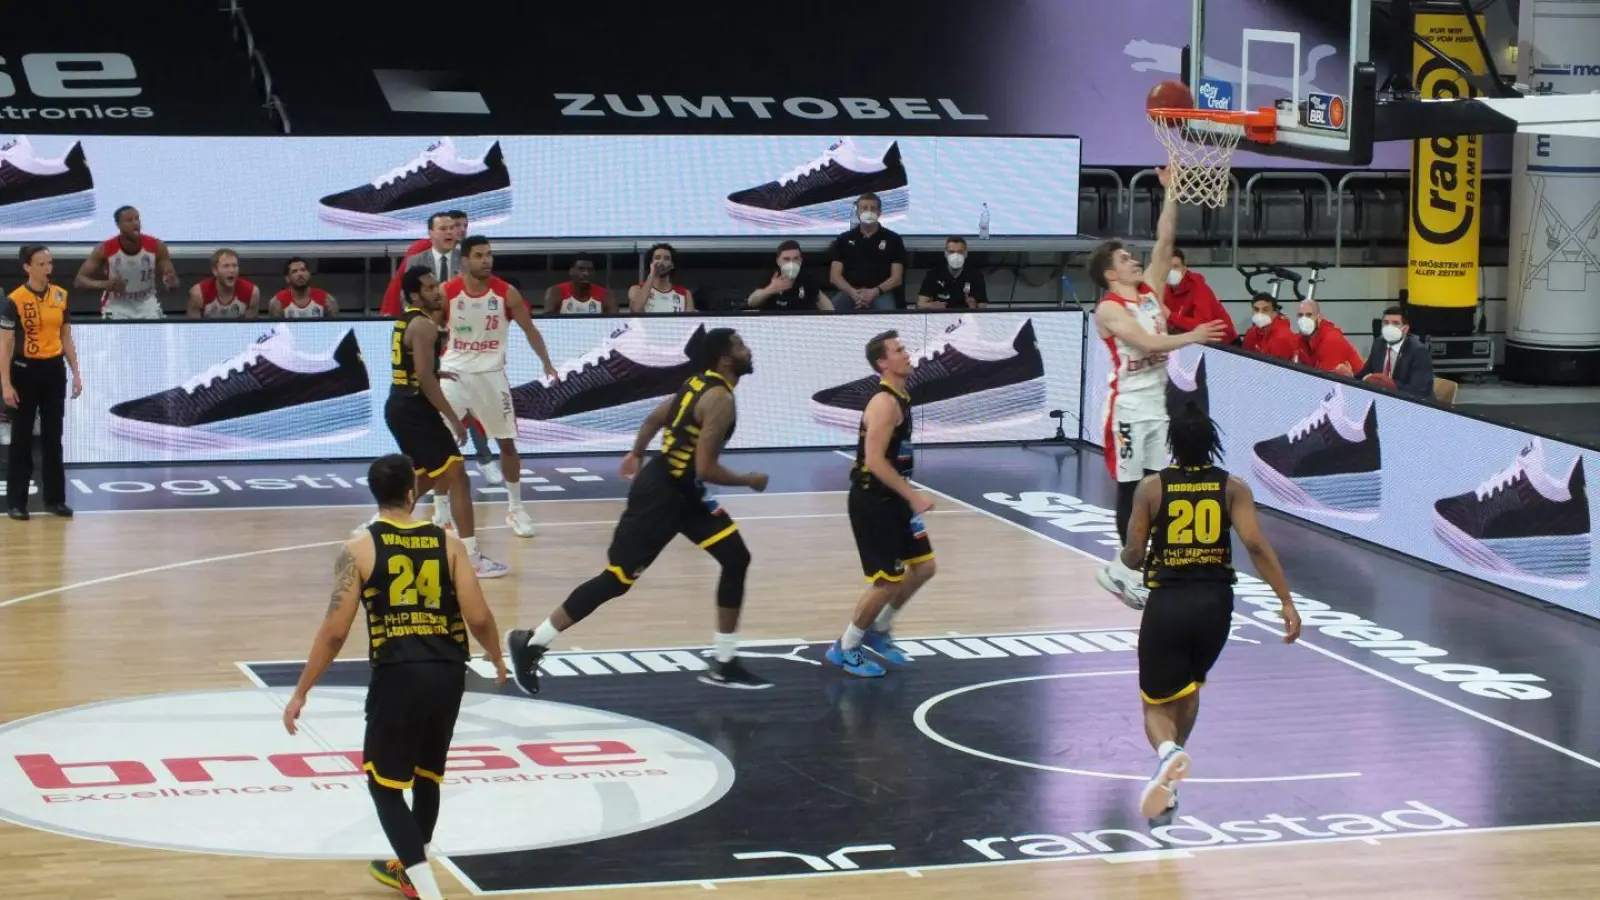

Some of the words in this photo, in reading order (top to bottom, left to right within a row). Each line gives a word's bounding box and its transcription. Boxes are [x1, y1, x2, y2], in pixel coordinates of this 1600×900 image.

[553, 93, 989, 120] ZUMTOBEL
[1310, 109, 1326, 124] BBL
[23, 302, 39, 354] GYMPER
[1167, 482, 1220, 492] RODRIGUEZ
[1167, 499, 1221, 544] 20
[381, 533, 440, 548] WARREN
[388, 554, 442, 609] 24
[41, 785, 294, 803] Excellence
[311, 781, 349, 790] in
[962, 801, 1468, 860] randstad
